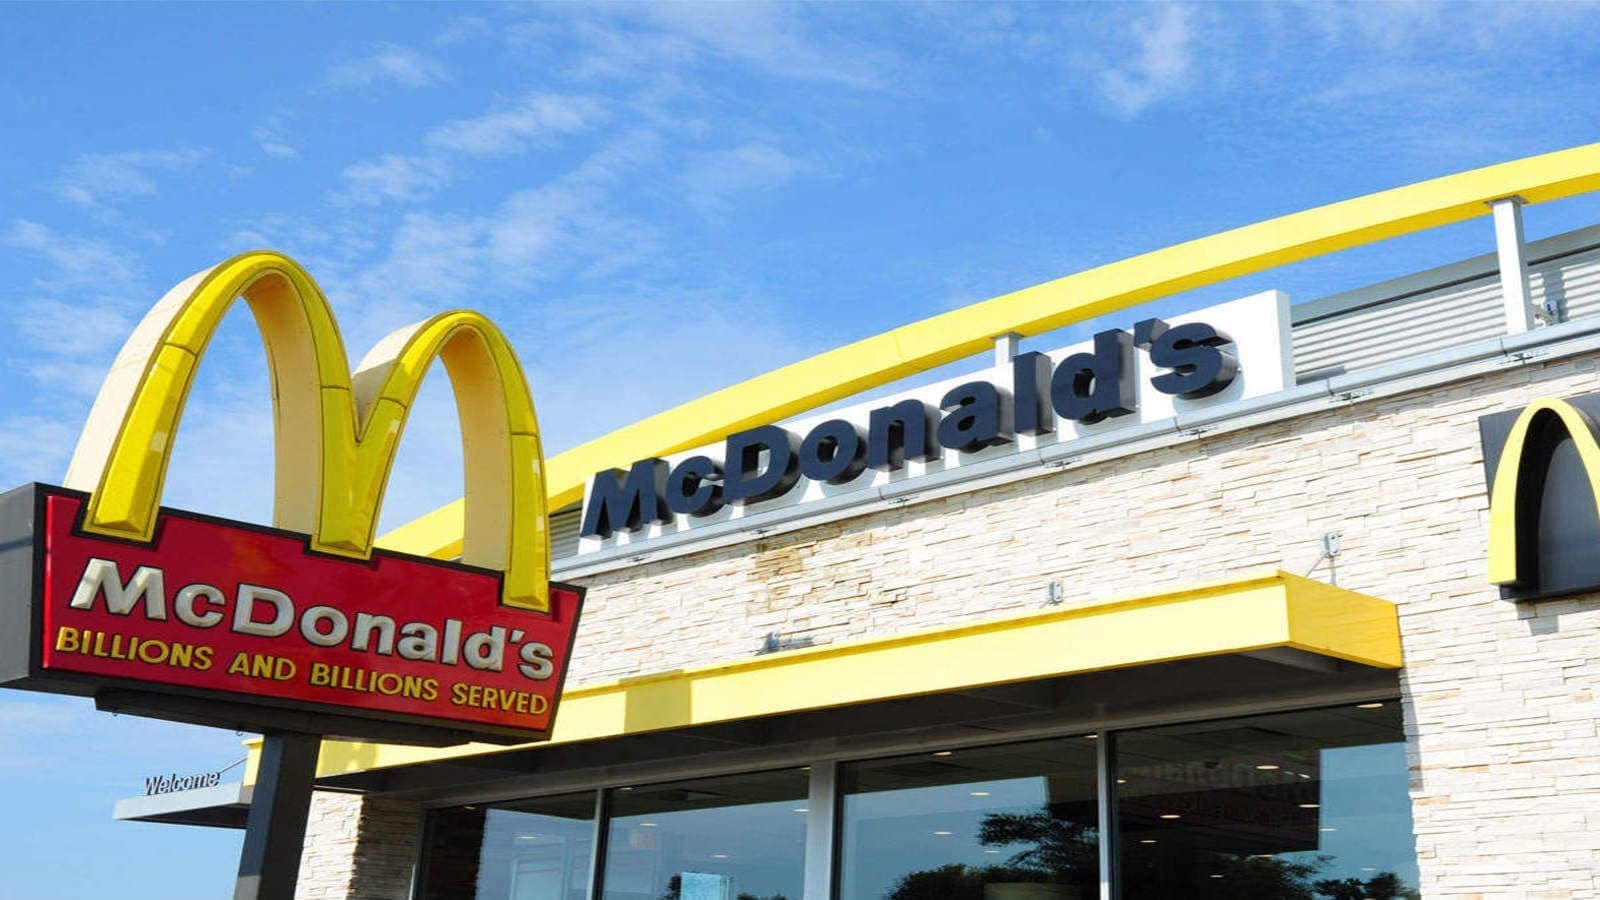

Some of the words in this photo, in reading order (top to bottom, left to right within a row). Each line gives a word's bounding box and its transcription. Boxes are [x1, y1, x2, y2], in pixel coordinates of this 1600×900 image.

[580, 319, 1237, 538] McDonald's
[55, 626, 213, 671] BILLIONS
[229, 652, 296, 681] AND
[311, 663, 438, 701] BILLIONS
[451, 682, 547, 716] SERVED
[70, 557, 554, 680] McDonald's
[146, 772, 220, 795] Welcome
